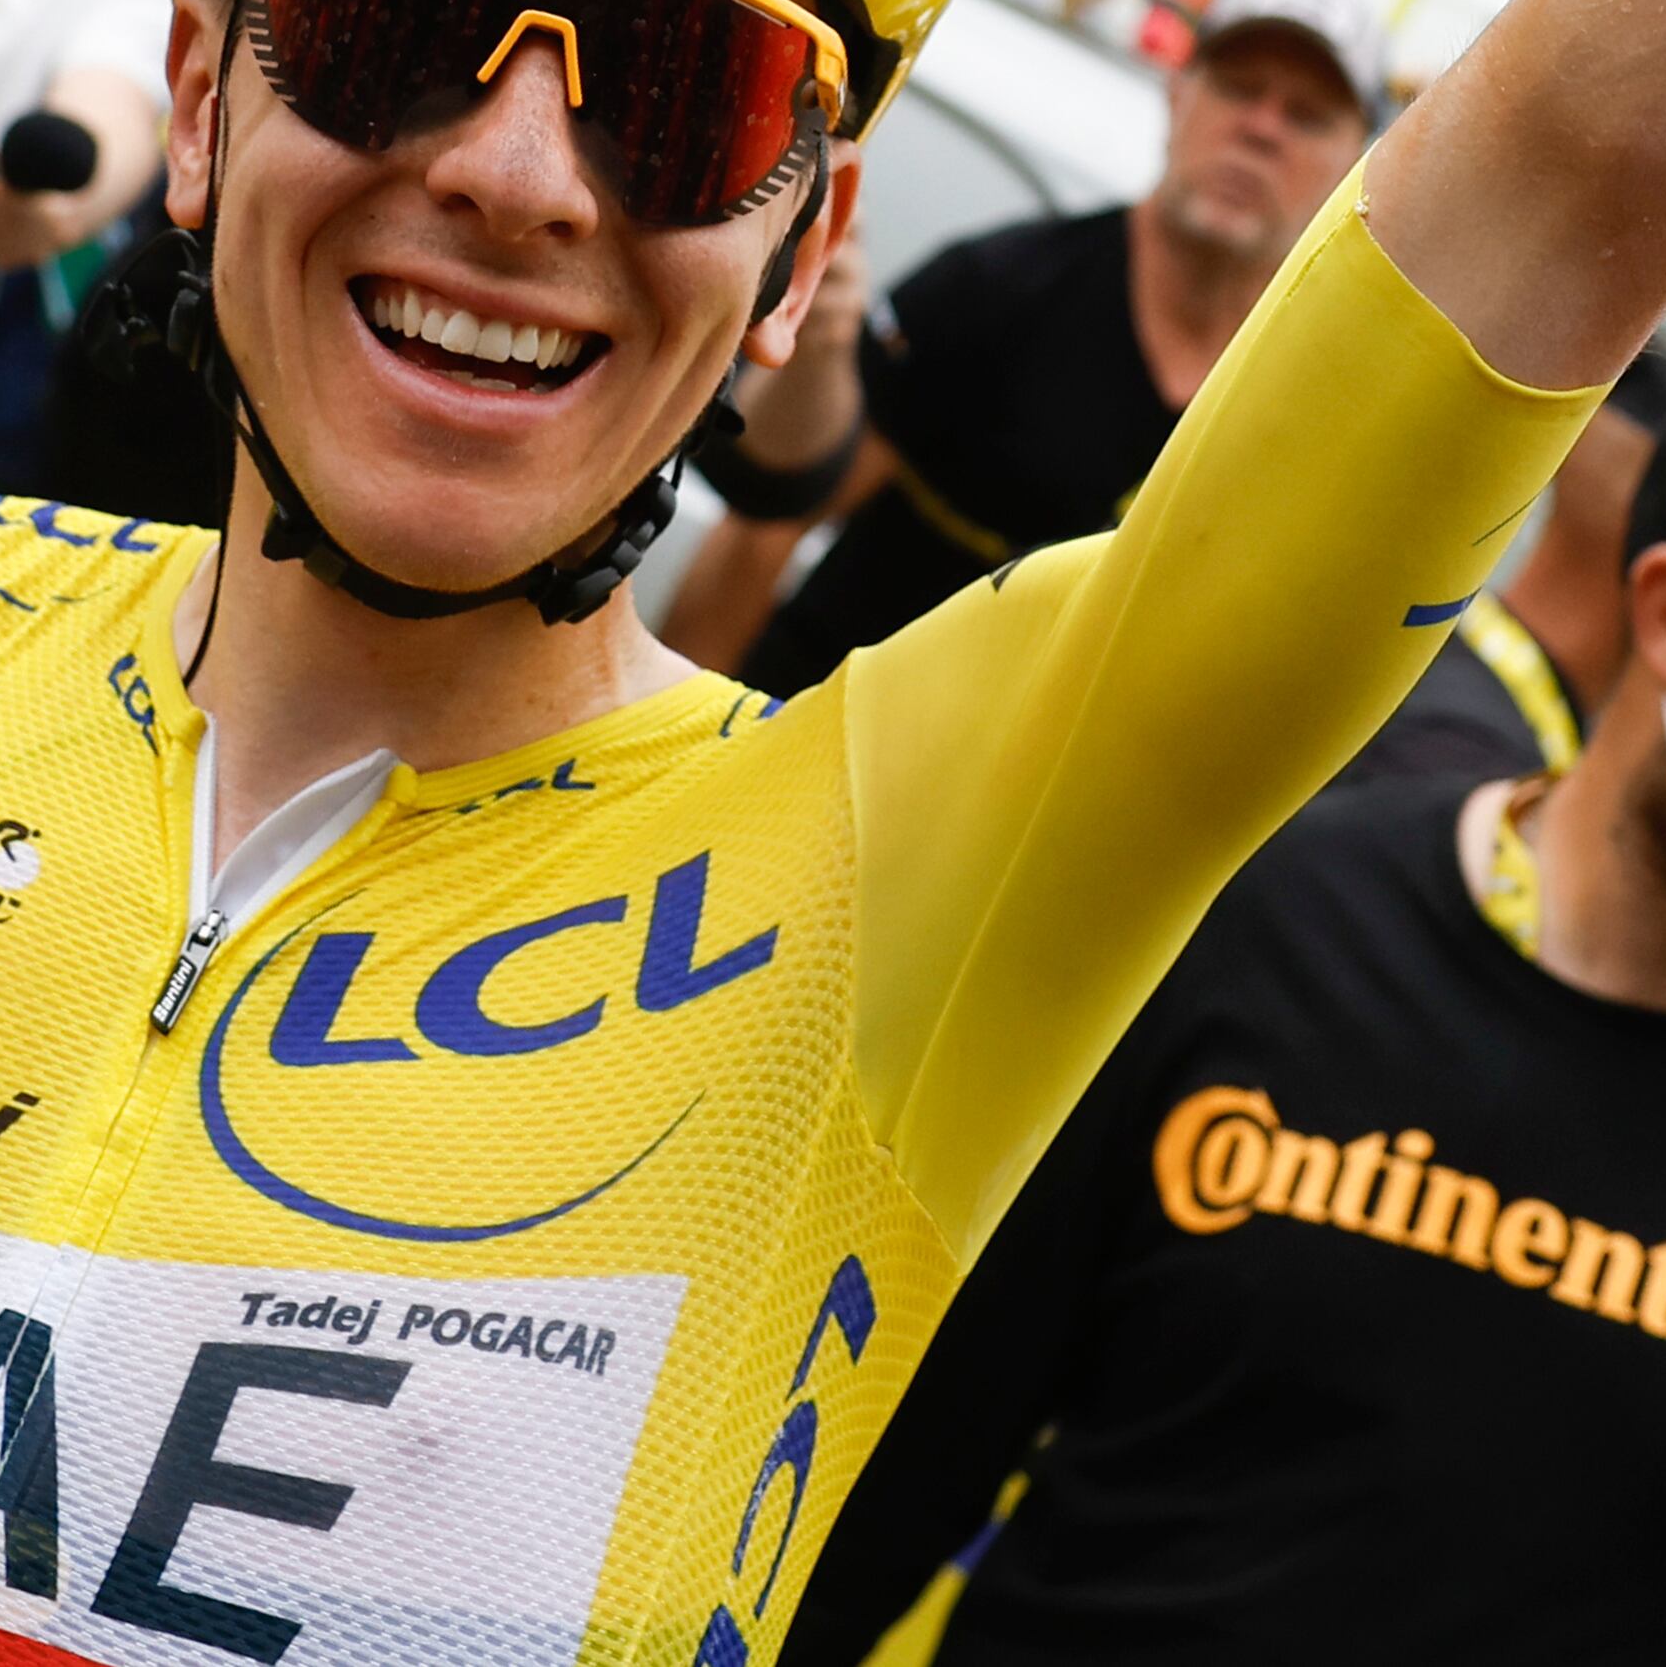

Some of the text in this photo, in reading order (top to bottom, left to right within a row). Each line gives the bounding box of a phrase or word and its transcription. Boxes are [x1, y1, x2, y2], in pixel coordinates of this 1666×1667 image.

[269, 850, 780, 1067] LCL
[241, 1291, 616, 1377] Tadej POGACAR
